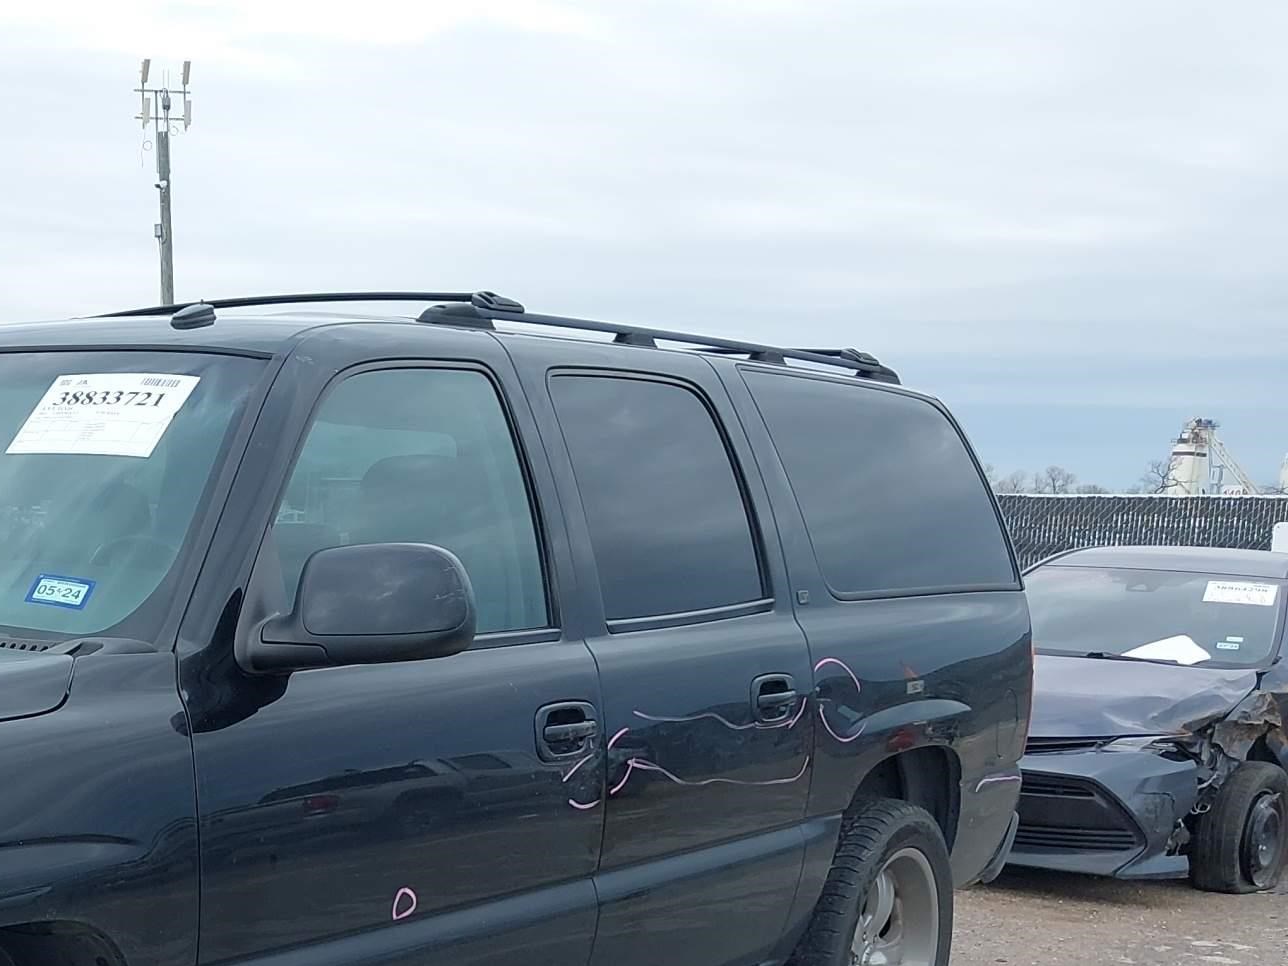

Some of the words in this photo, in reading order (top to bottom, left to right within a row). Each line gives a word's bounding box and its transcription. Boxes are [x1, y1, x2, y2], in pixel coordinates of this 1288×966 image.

[52, 390, 166, 408] 38833721
[36, 584, 58, 597] 05
[60, 586, 81, 600] 24
